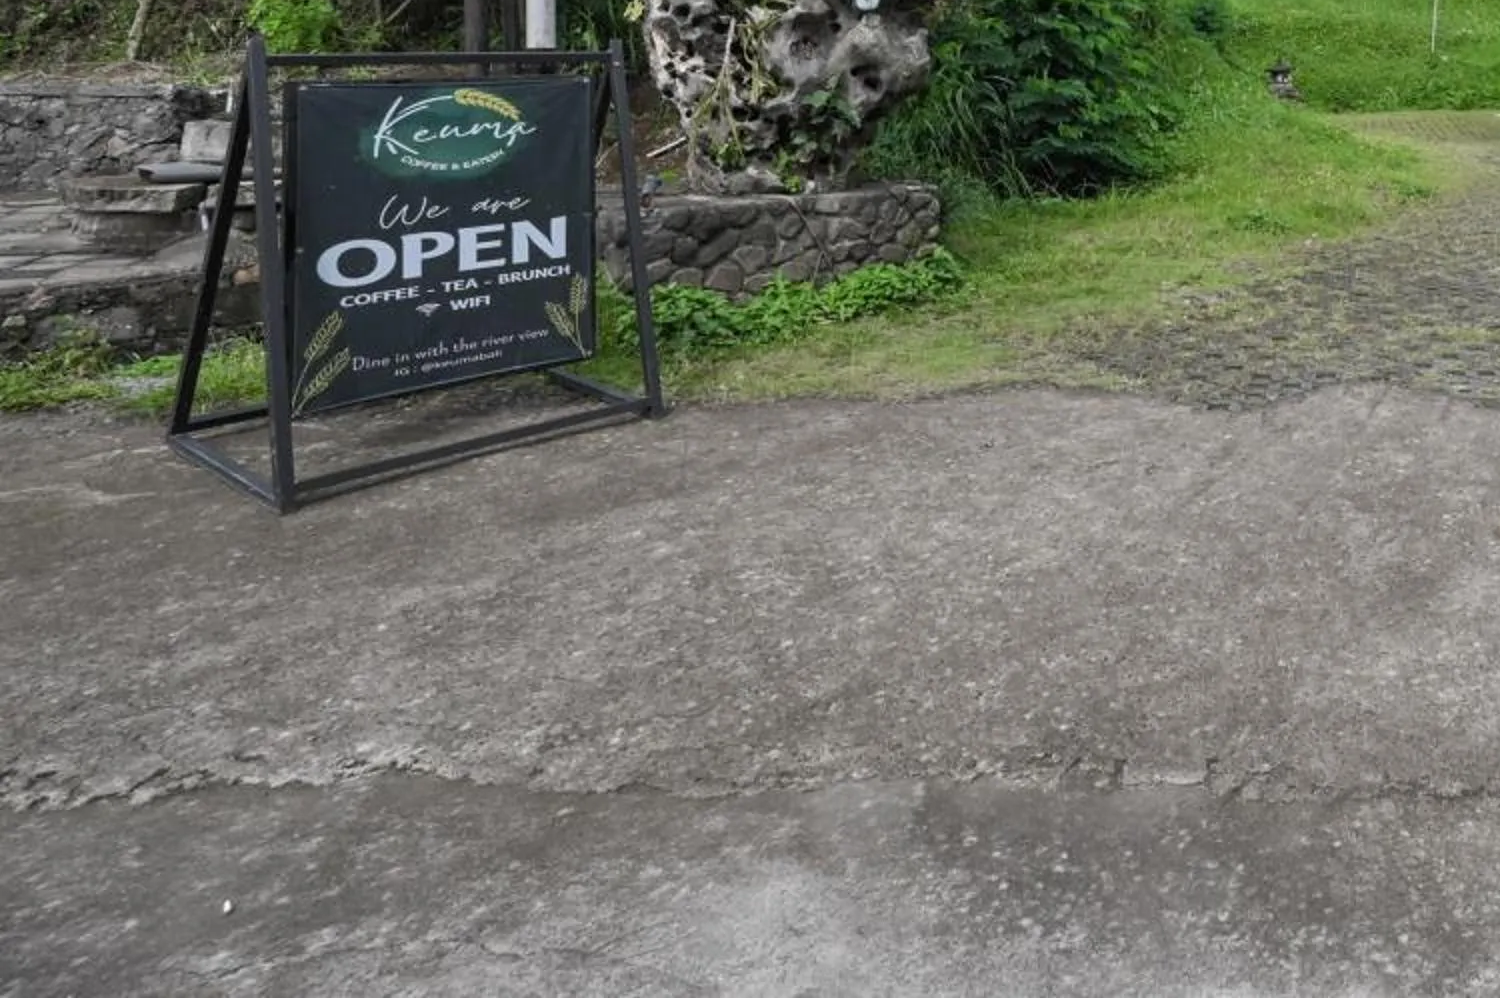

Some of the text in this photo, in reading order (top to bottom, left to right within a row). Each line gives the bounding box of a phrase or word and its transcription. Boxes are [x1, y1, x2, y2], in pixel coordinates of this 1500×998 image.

[379, 194, 532, 230] We are
[316, 215, 567, 288] OPEN
[340, 285, 419, 309] COFFEE
[440, 277, 479, 294] TEA
[497, 264, 571, 286] BRUNCH
[450, 294, 491, 312] WIFI
[352, 328, 549, 372] Dine in with the river view
